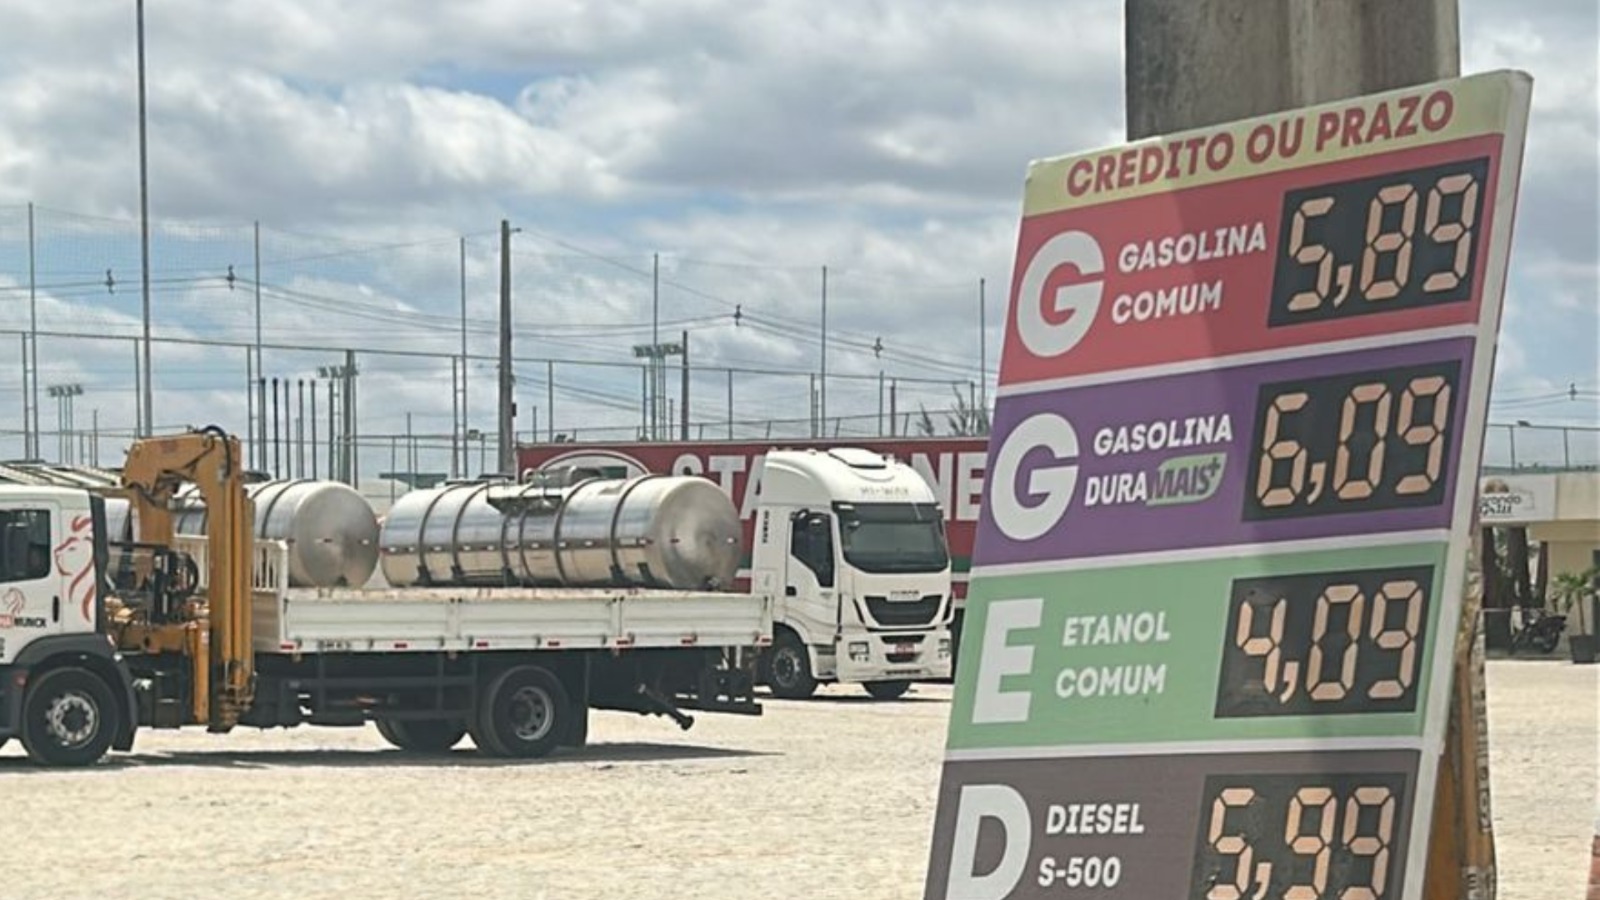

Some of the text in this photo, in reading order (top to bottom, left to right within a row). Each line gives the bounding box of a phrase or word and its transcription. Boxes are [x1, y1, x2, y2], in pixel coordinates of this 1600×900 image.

[1067, 90, 1454, 198] CREDITO OU PRAZO
[1016, 230, 1105, 358] G
[1118, 222, 1267, 274] GASOLINA
[1287, 173, 1479, 313] 5,89
[1111, 281, 1224, 325] COMUM
[990, 413, 1080, 542] G
[1093, 414, 1233, 456] GASOLINA
[1256, 375, 1451, 508] 6,09
[972, 598, 1044, 723] E
[1055, 664, 1167, 699] COMUM
[1062, 611, 1171, 647] ETANOL
[1236, 579, 1423, 703] 4,09
[945, 784, 1032, 900] D
[1038, 856, 1121, 888] S-500
[1046, 803, 1145, 835] DIESEL
[1205, 787, 1395, 900] 5,99
